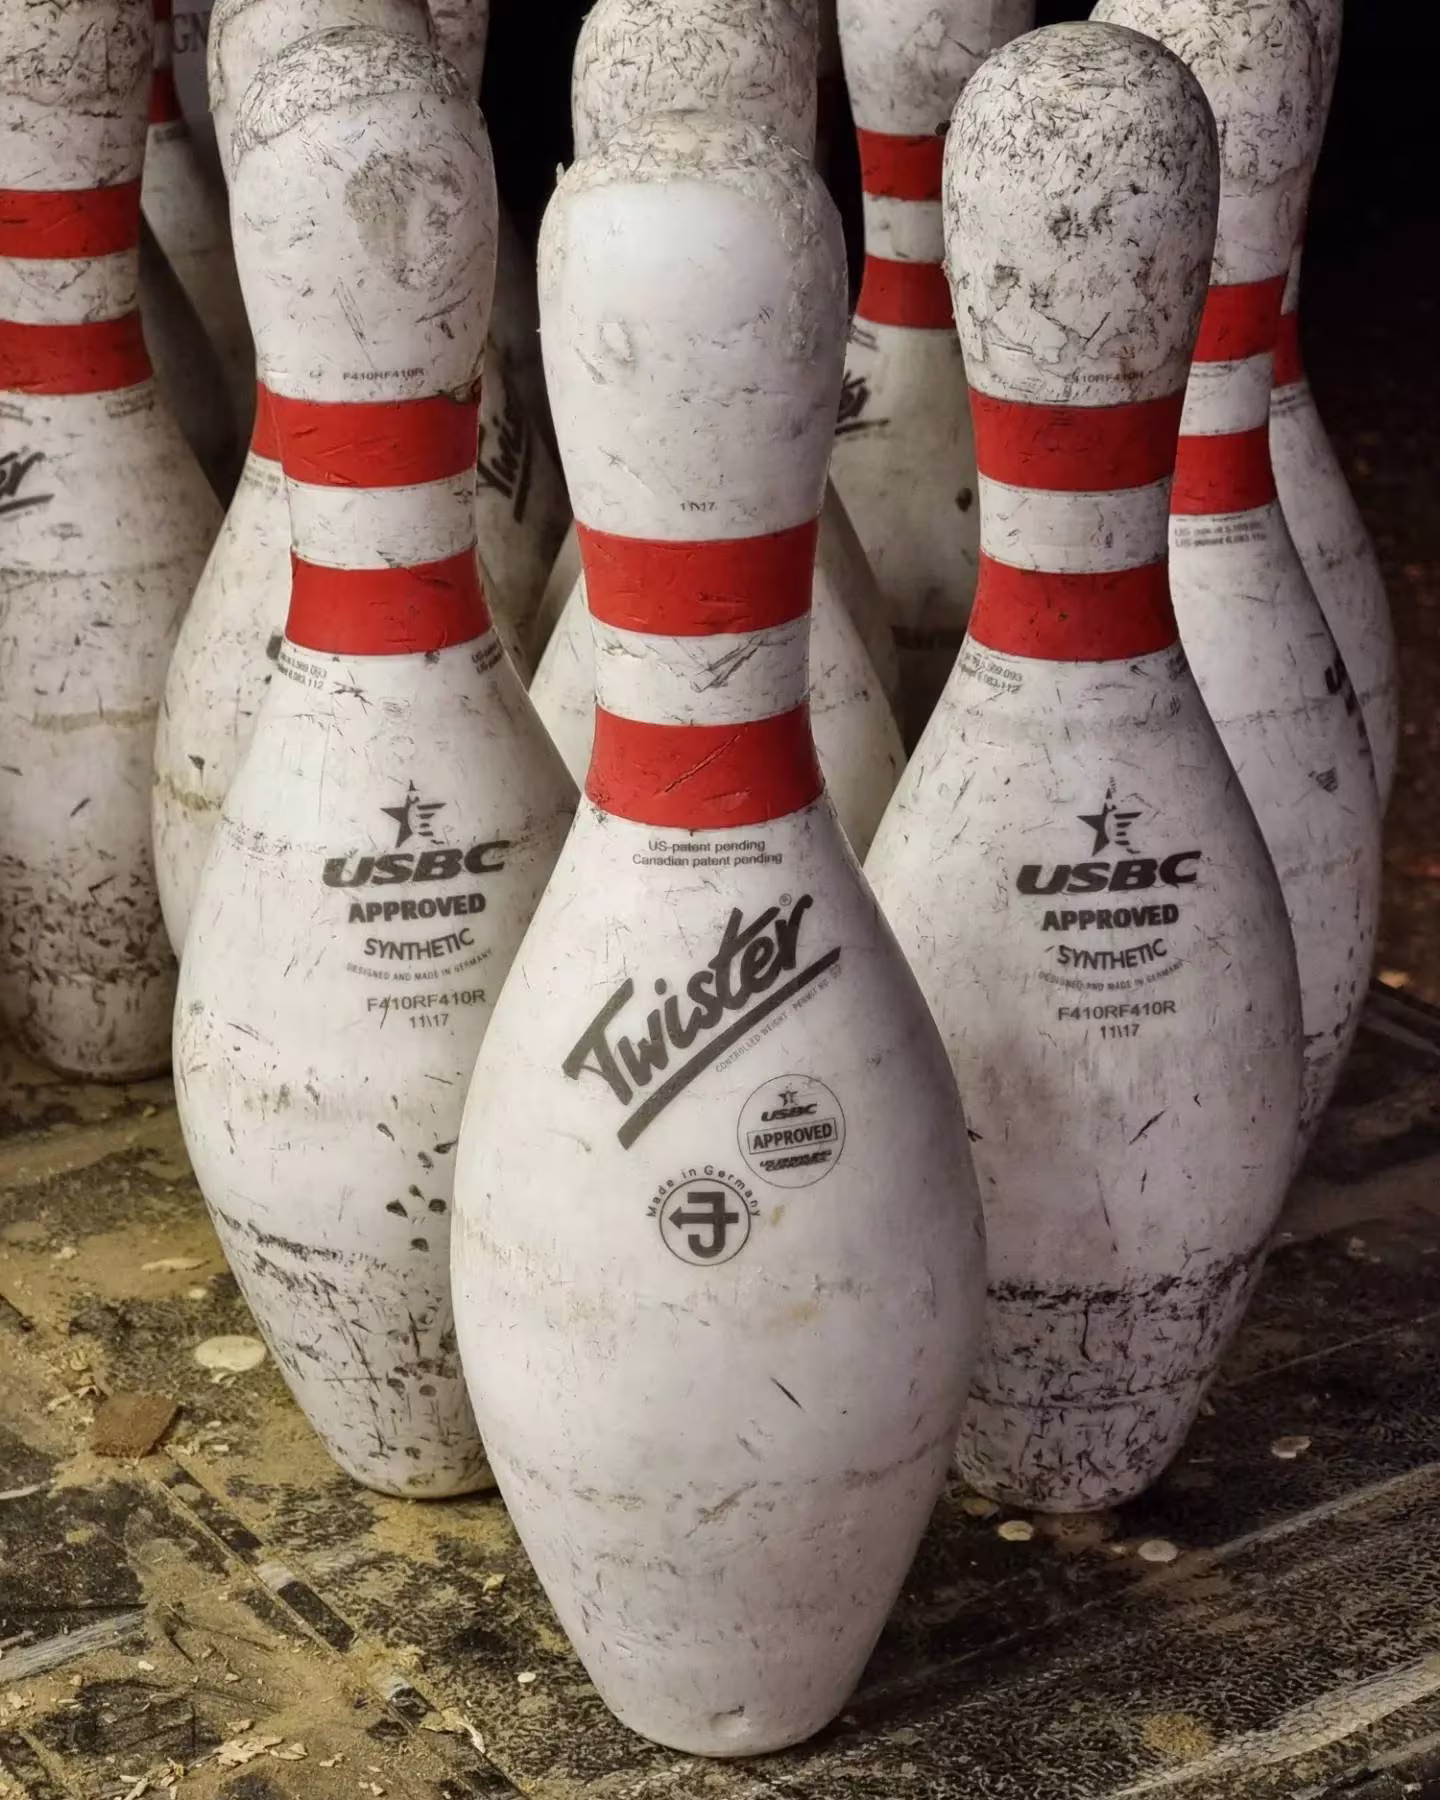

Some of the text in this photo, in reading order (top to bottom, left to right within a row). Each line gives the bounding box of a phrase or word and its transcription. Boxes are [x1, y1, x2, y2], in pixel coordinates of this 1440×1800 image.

[715, 839, 765, 853] pending
[323, 840, 510, 888] USBC
[632, 852, 783, 868] Canadian patent pending
[1016, 851, 1202, 895] USBC
[348, 893, 486, 924] APPROVED
[1041, 903, 1179, 931] APPROVED
[364, 928, 475, 960] SYNTHETIC
[1057, 938, 1167, 970] SYNTHETIC
[393, 970, 412, 981] AND
[415, 970, 439, 980] MADE
[442, 967, 451, 976] IN
[367, 989, 486, 1012] F410RF410R
[1058, 1000, 1176, 1021] F410RF410R
[761, 1103, 817, 1122] USBC
[753, 1123, 832, 1149] APPROVED
[646, 1165, 761, 1217] Made in Germany
